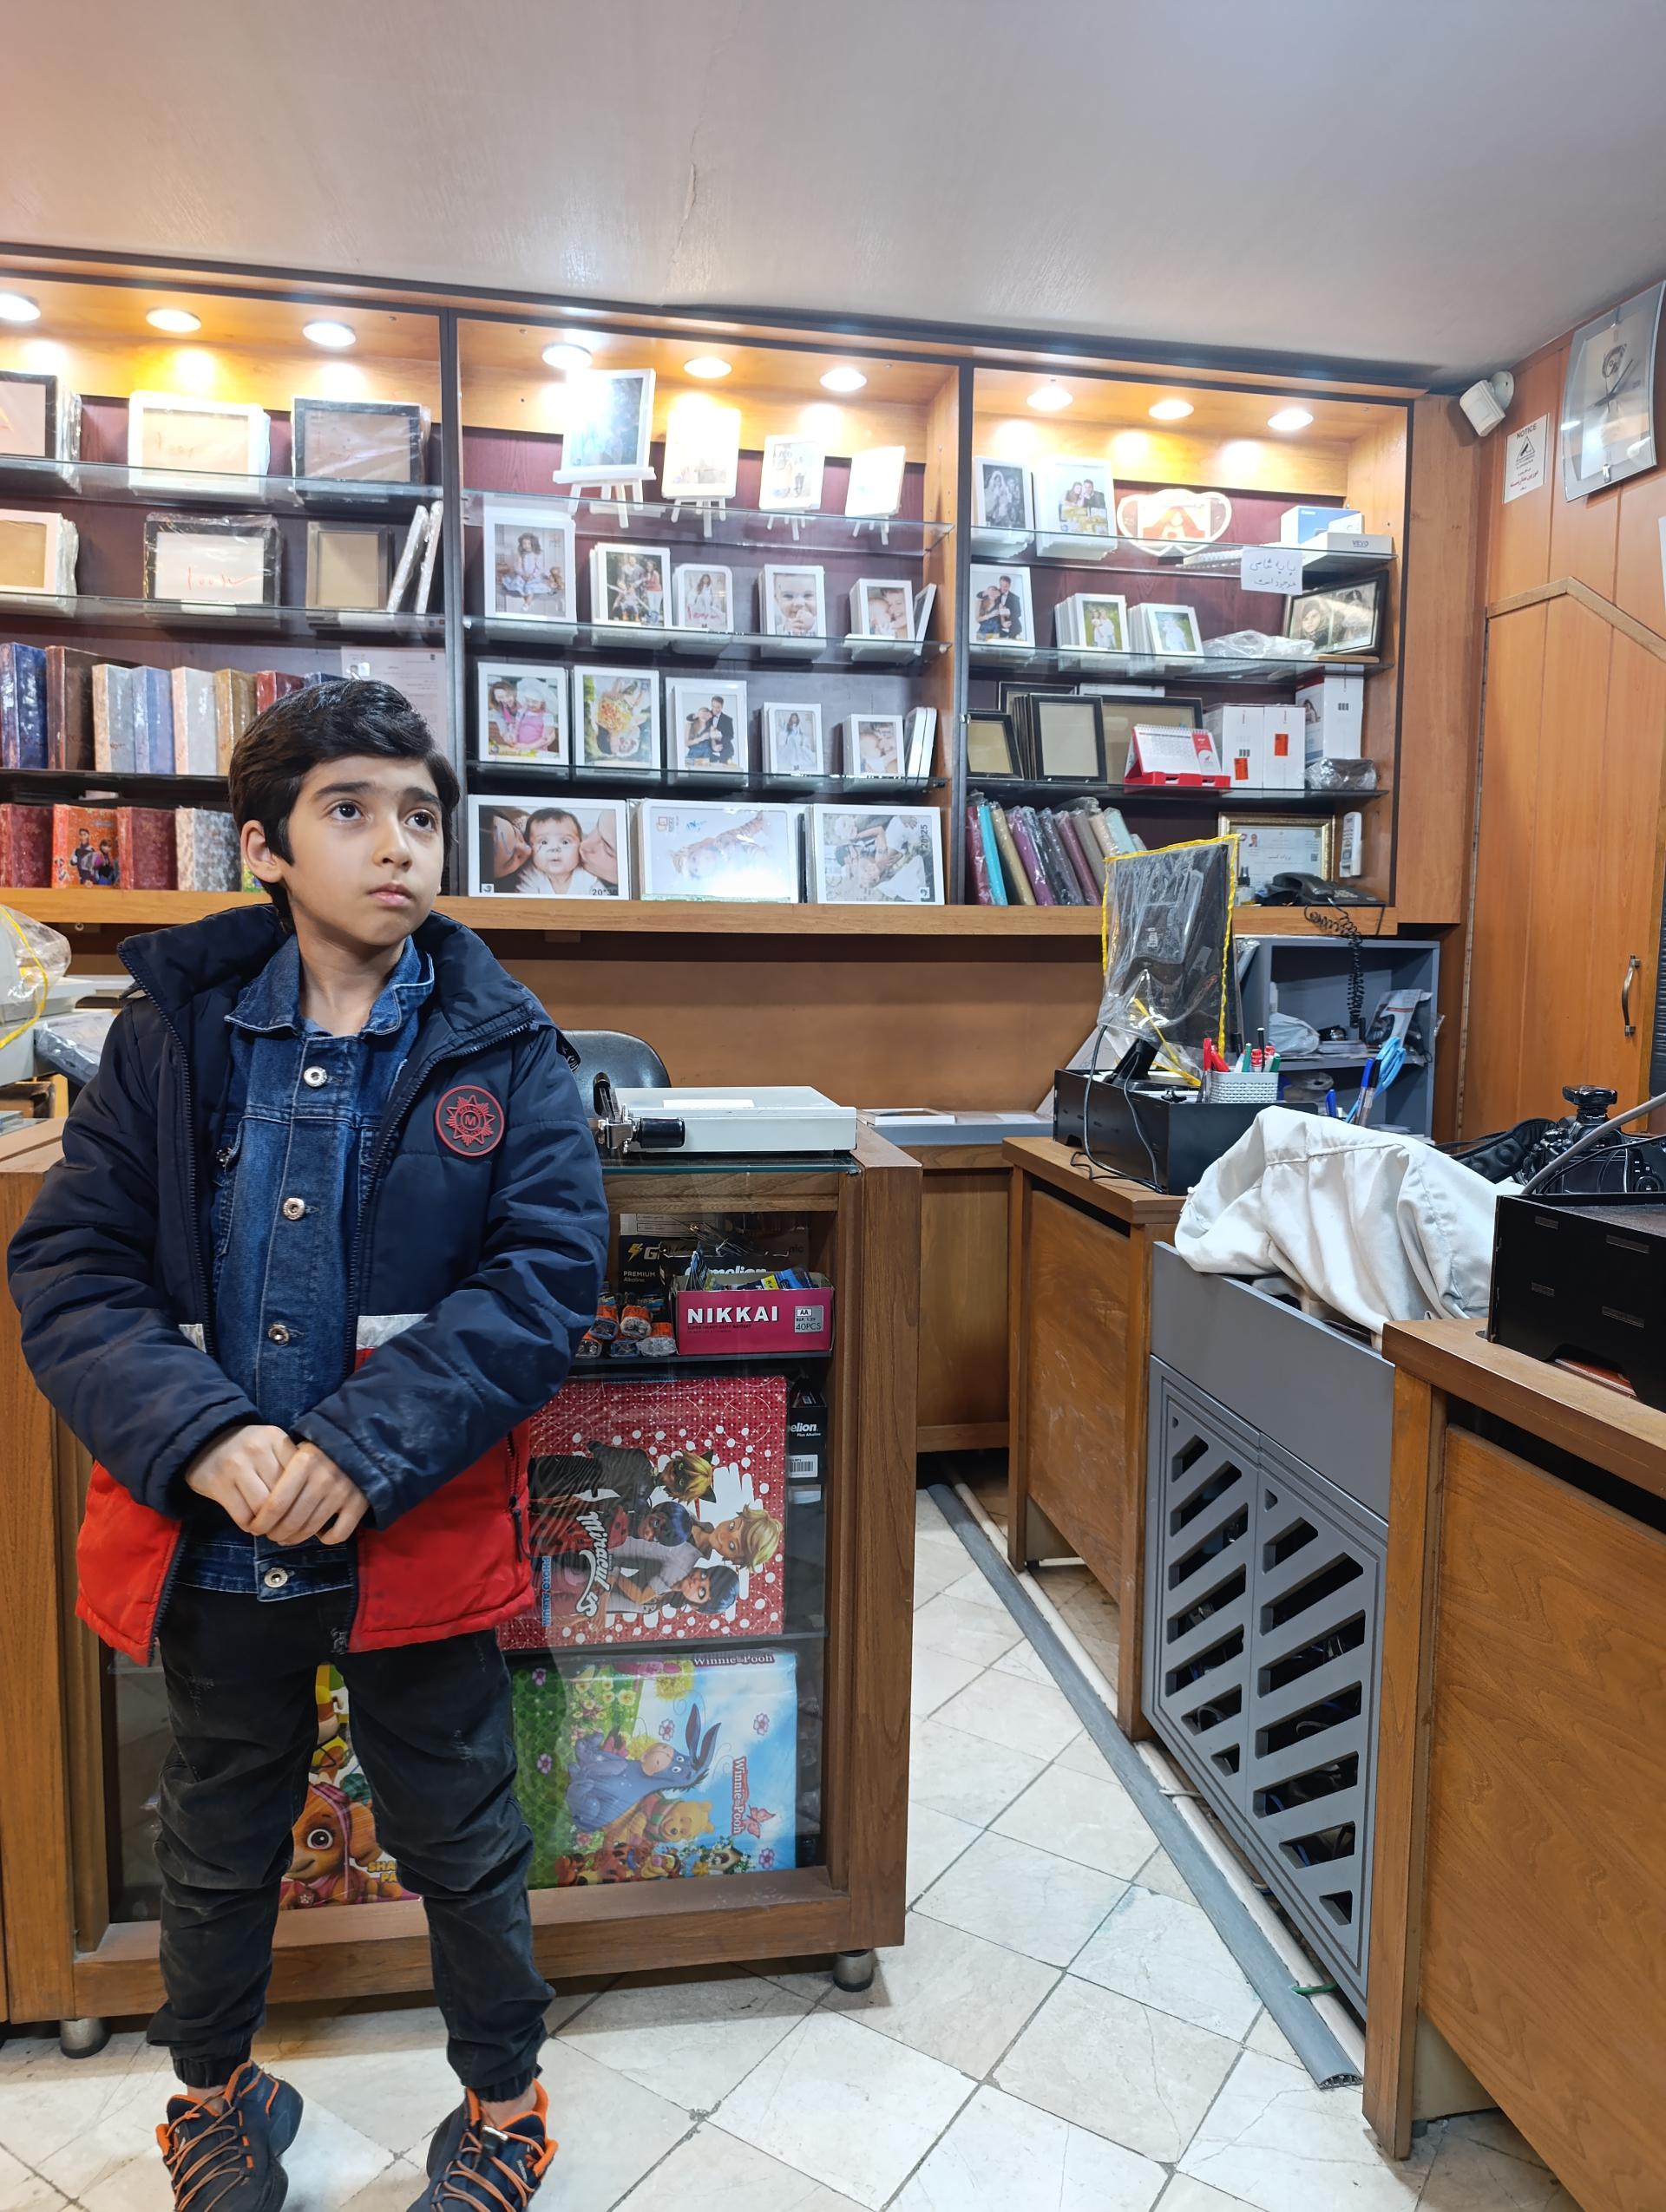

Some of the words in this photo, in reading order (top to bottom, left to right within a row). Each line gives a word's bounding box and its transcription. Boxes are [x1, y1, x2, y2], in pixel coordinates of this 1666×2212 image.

[1516, 423, 1537, 440] NOTICE
[464, 1115, 476, 1126] M
[687, 1306, 778, 1324] NIKKAI
[796, 1322, 822, 1331] 40PCS
[541, 1555, 552, 1591] PHOTO
[576, 1511, 611, 1616] Miraculus
[541, 1591, 552, 1627] ALBUM
[693, 1657, 737, 1666] Winnie
[744, 1652, 775, 1664] Pooh
[733, 1757, 746, 1799] Winnie
[733, 1804, 744, 1834] Pooh
